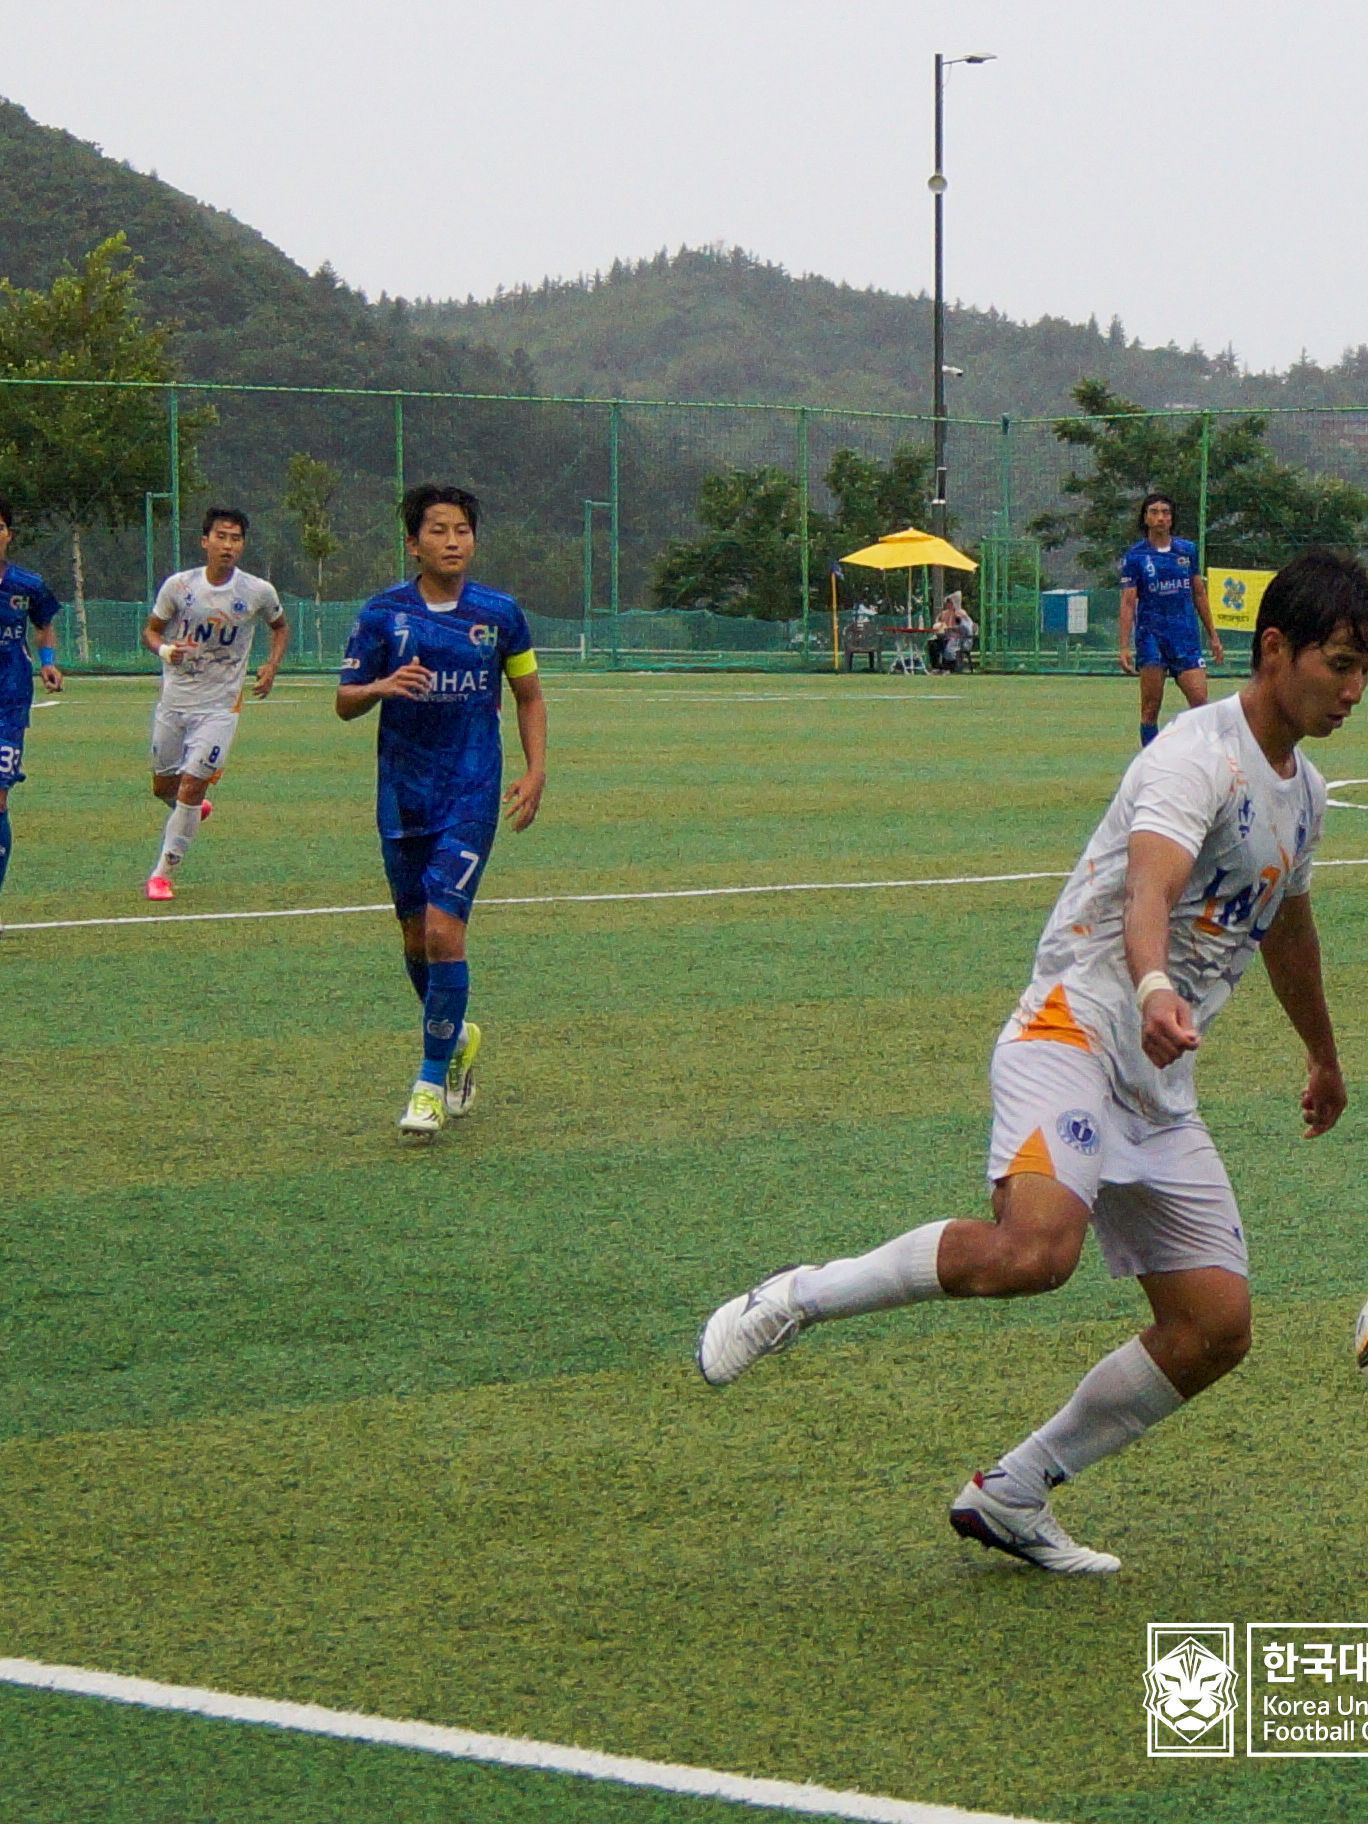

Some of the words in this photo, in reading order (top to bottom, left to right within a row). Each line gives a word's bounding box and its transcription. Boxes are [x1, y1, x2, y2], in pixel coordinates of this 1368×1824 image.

[182, 618, 239, 646] INU
[394, 629, 410, 658] 7
[208, 745, 221, 764] 8
[455, 850, 479, 890] 7
